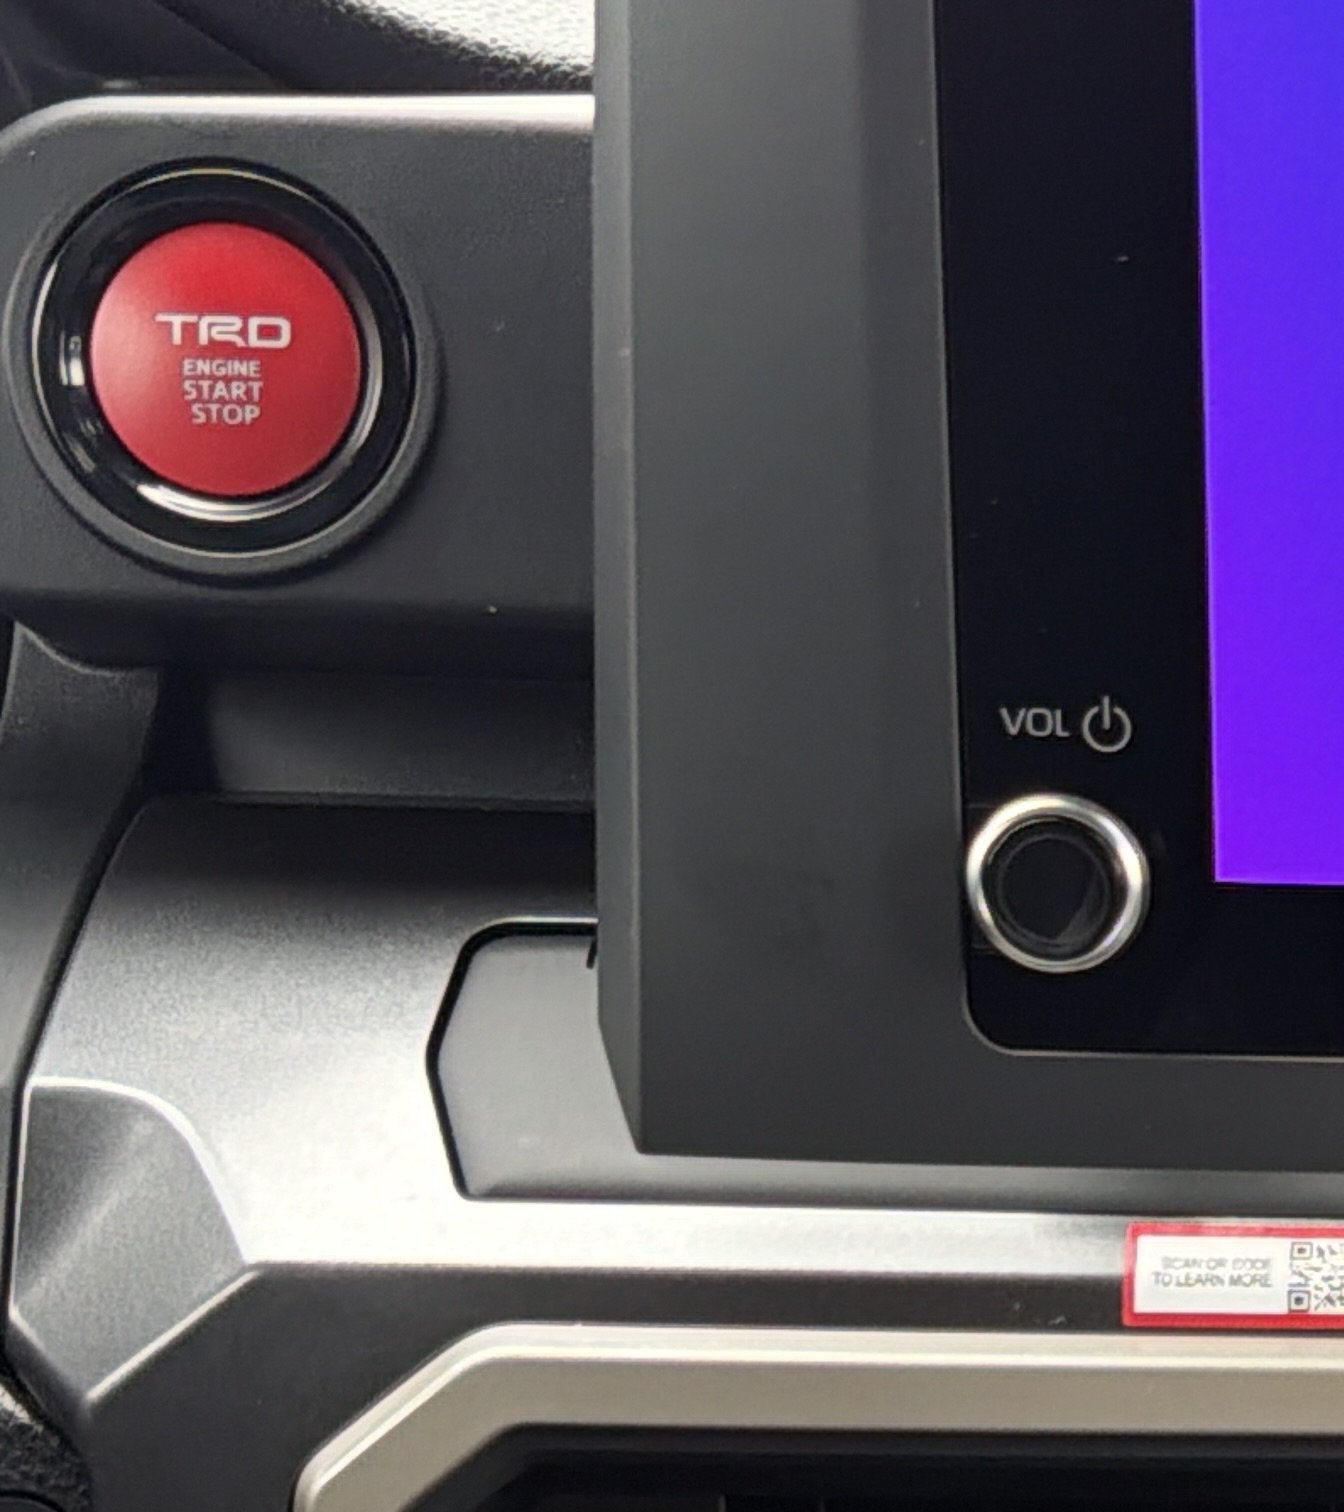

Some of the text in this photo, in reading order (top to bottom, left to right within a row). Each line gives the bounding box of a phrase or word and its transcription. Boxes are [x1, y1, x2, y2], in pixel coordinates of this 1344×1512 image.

[154, 313, 292, 350] TRD
[182, 358, 262, 378] ENGINE
[183, 379, 264, 403] START
[191, 403, 261, 426] STOP
[999, 707, 1070, 738] VOL
[1152, 1271, 1274, 1288] TO LEARN MORE
